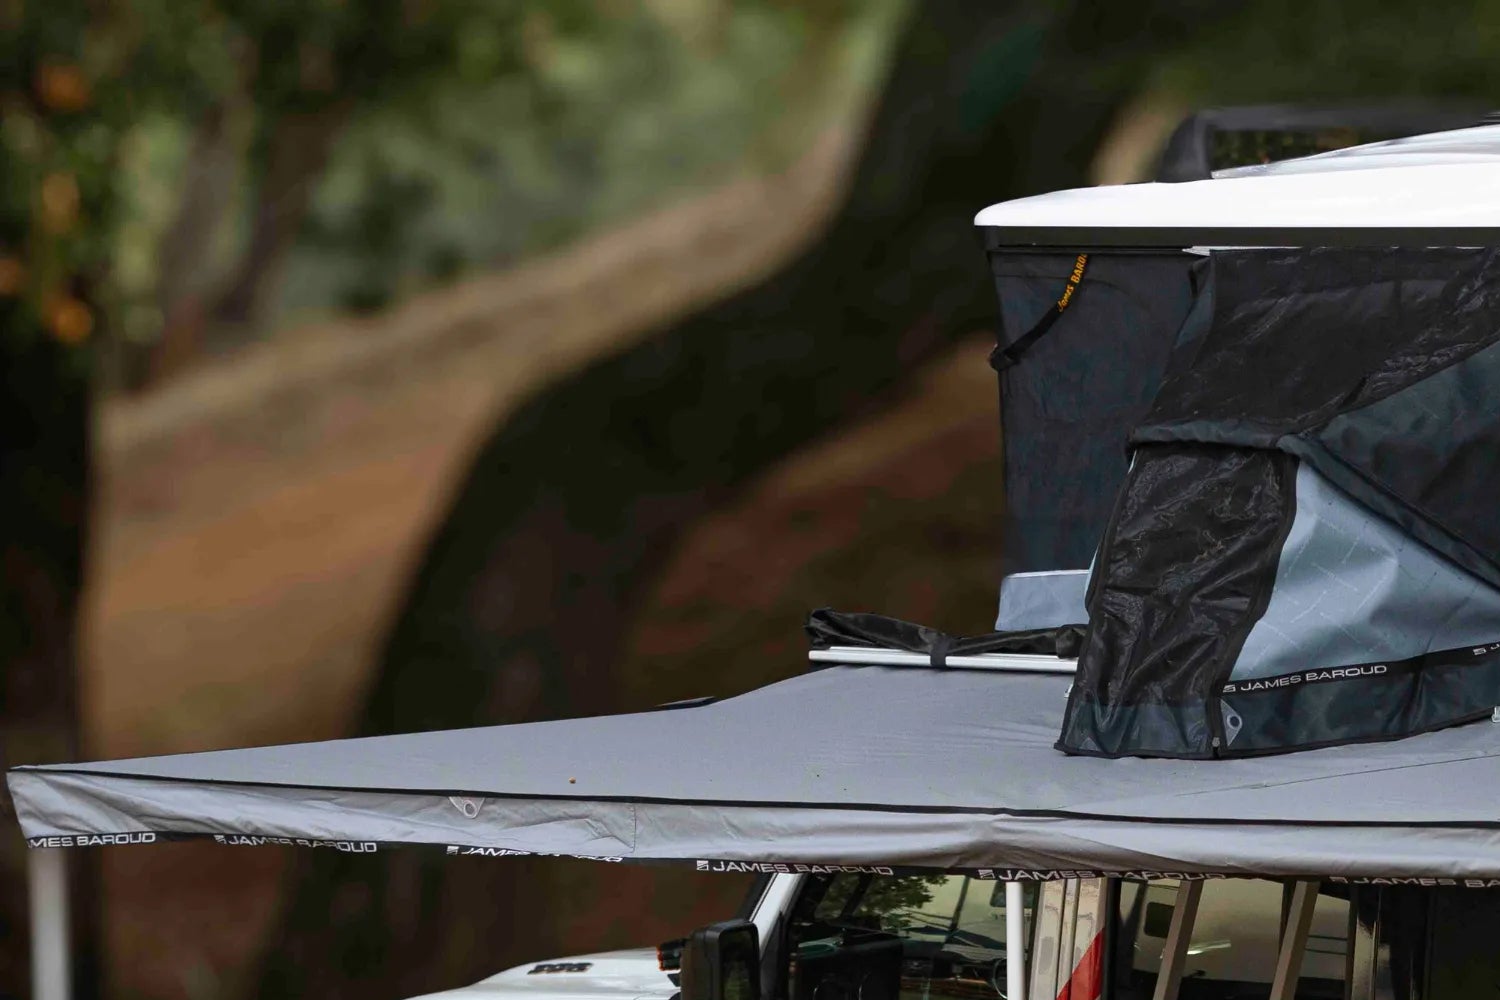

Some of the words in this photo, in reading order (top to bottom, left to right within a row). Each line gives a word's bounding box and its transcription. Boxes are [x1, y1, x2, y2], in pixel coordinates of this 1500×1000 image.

[1240, 674, 1301, 692] JAMES
[1305, 664, 1387, 681] BAROUD
[76, 832, 156, 847] BAROUD
[712, 861, 790, 874] JAMES
[793, 864, 894, 876] BAROUD
[998, 869, 1096, 882] JAMES
[1353, 877, 1457, 887] JAMES
